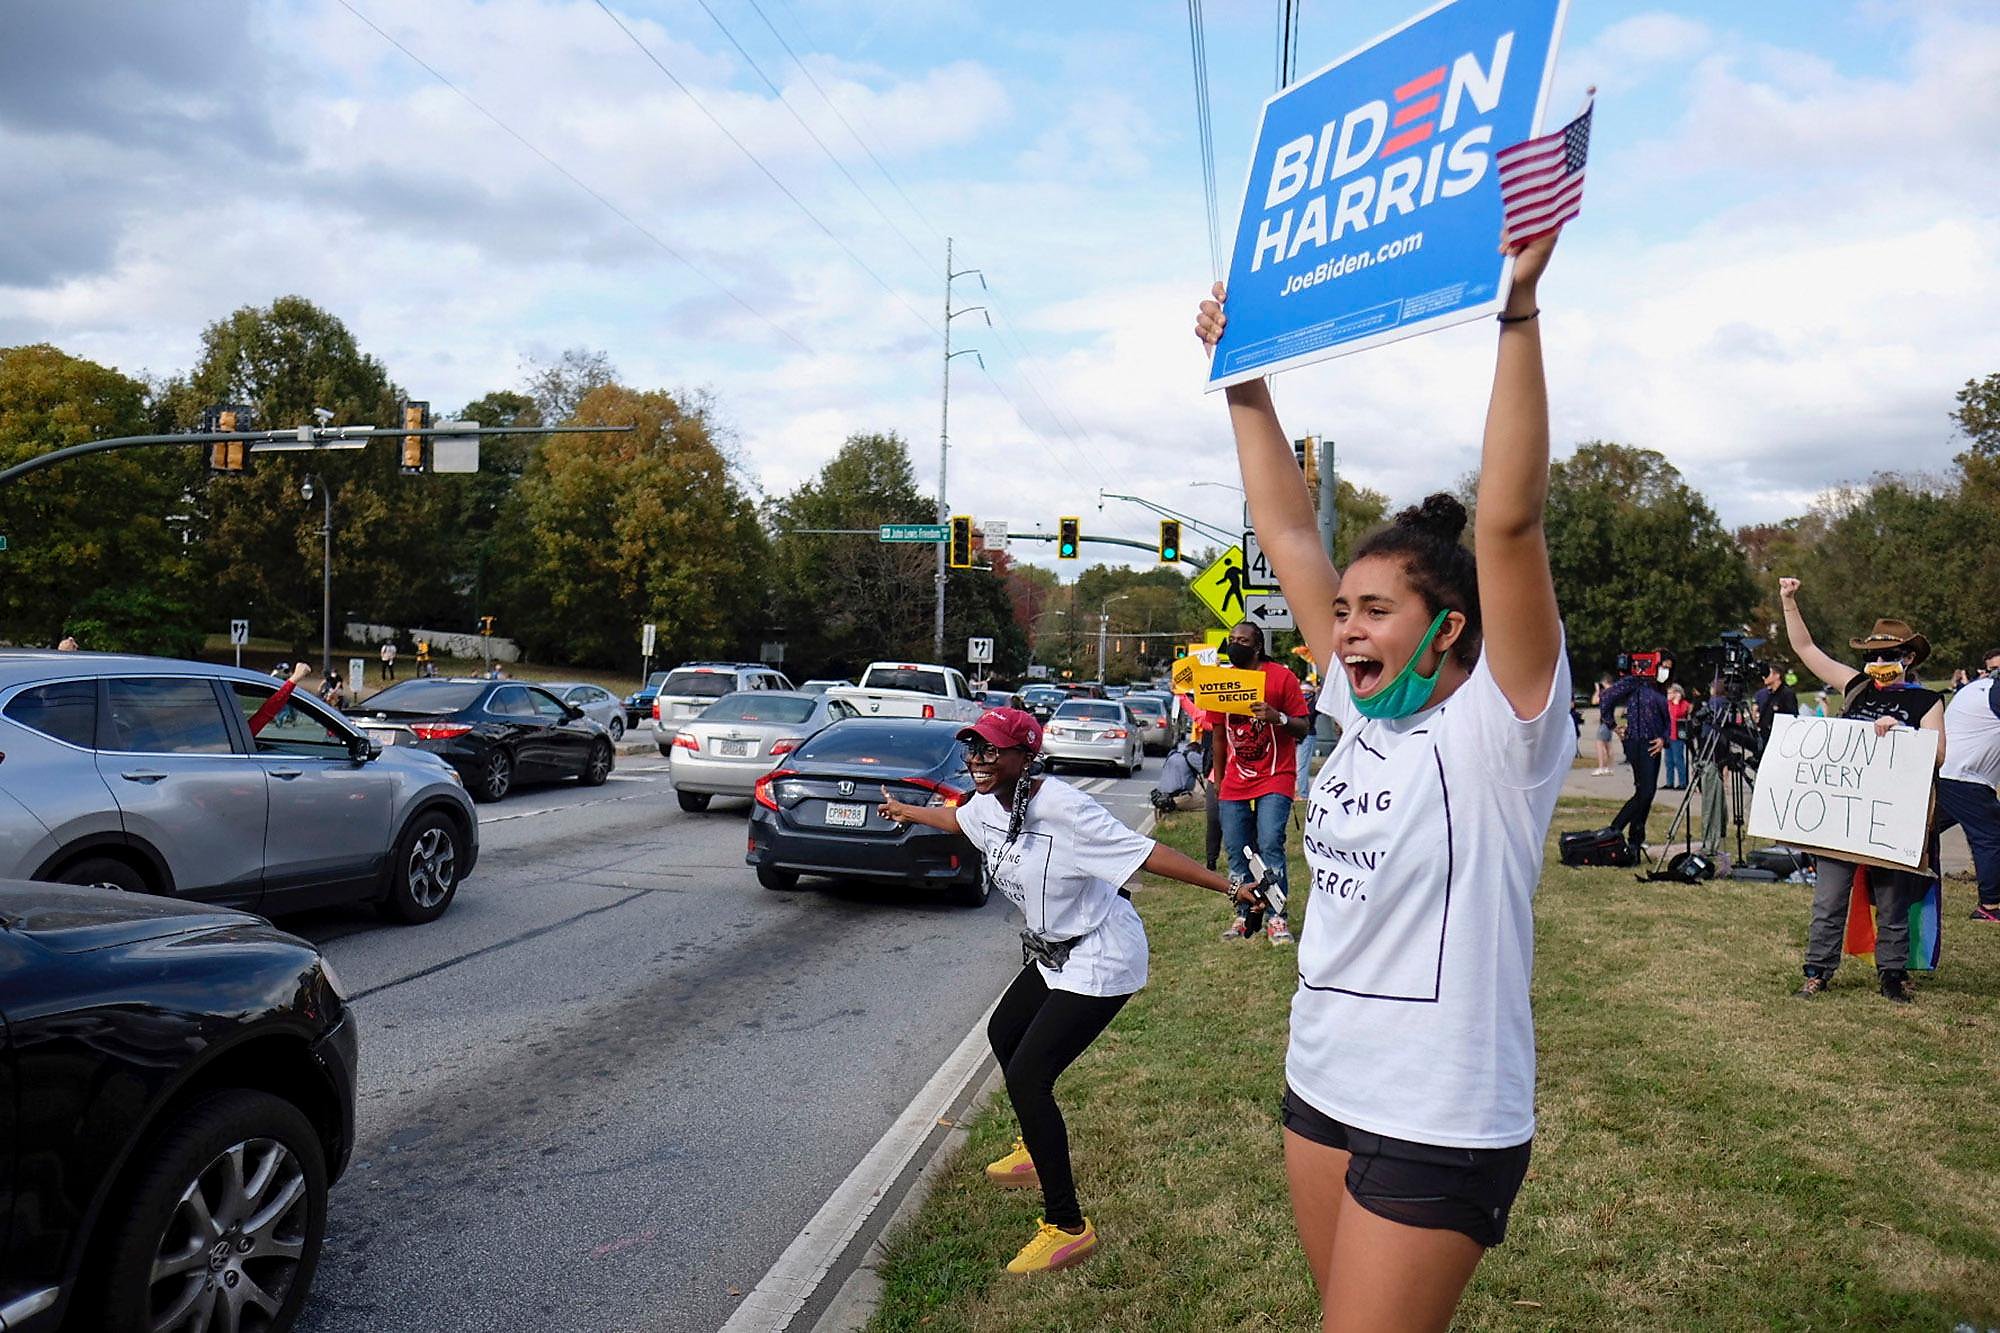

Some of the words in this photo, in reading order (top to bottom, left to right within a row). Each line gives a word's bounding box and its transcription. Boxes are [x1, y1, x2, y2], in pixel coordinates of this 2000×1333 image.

[1264, 31, 1515, 210] BIDEN
[1250, 125, 1493, 273] HARRIS
[1280, 232, 1423, 297] JoeBiden.com
[1200, 682, 1241, 692] VOTERS
[1218, 692, 1257, 702] DECIDE
[1779, 719, 1909, 770] COUNT
[1795, 762, 1864, 790] EVERY
[1769, 787, 1897, 850] VOTE
